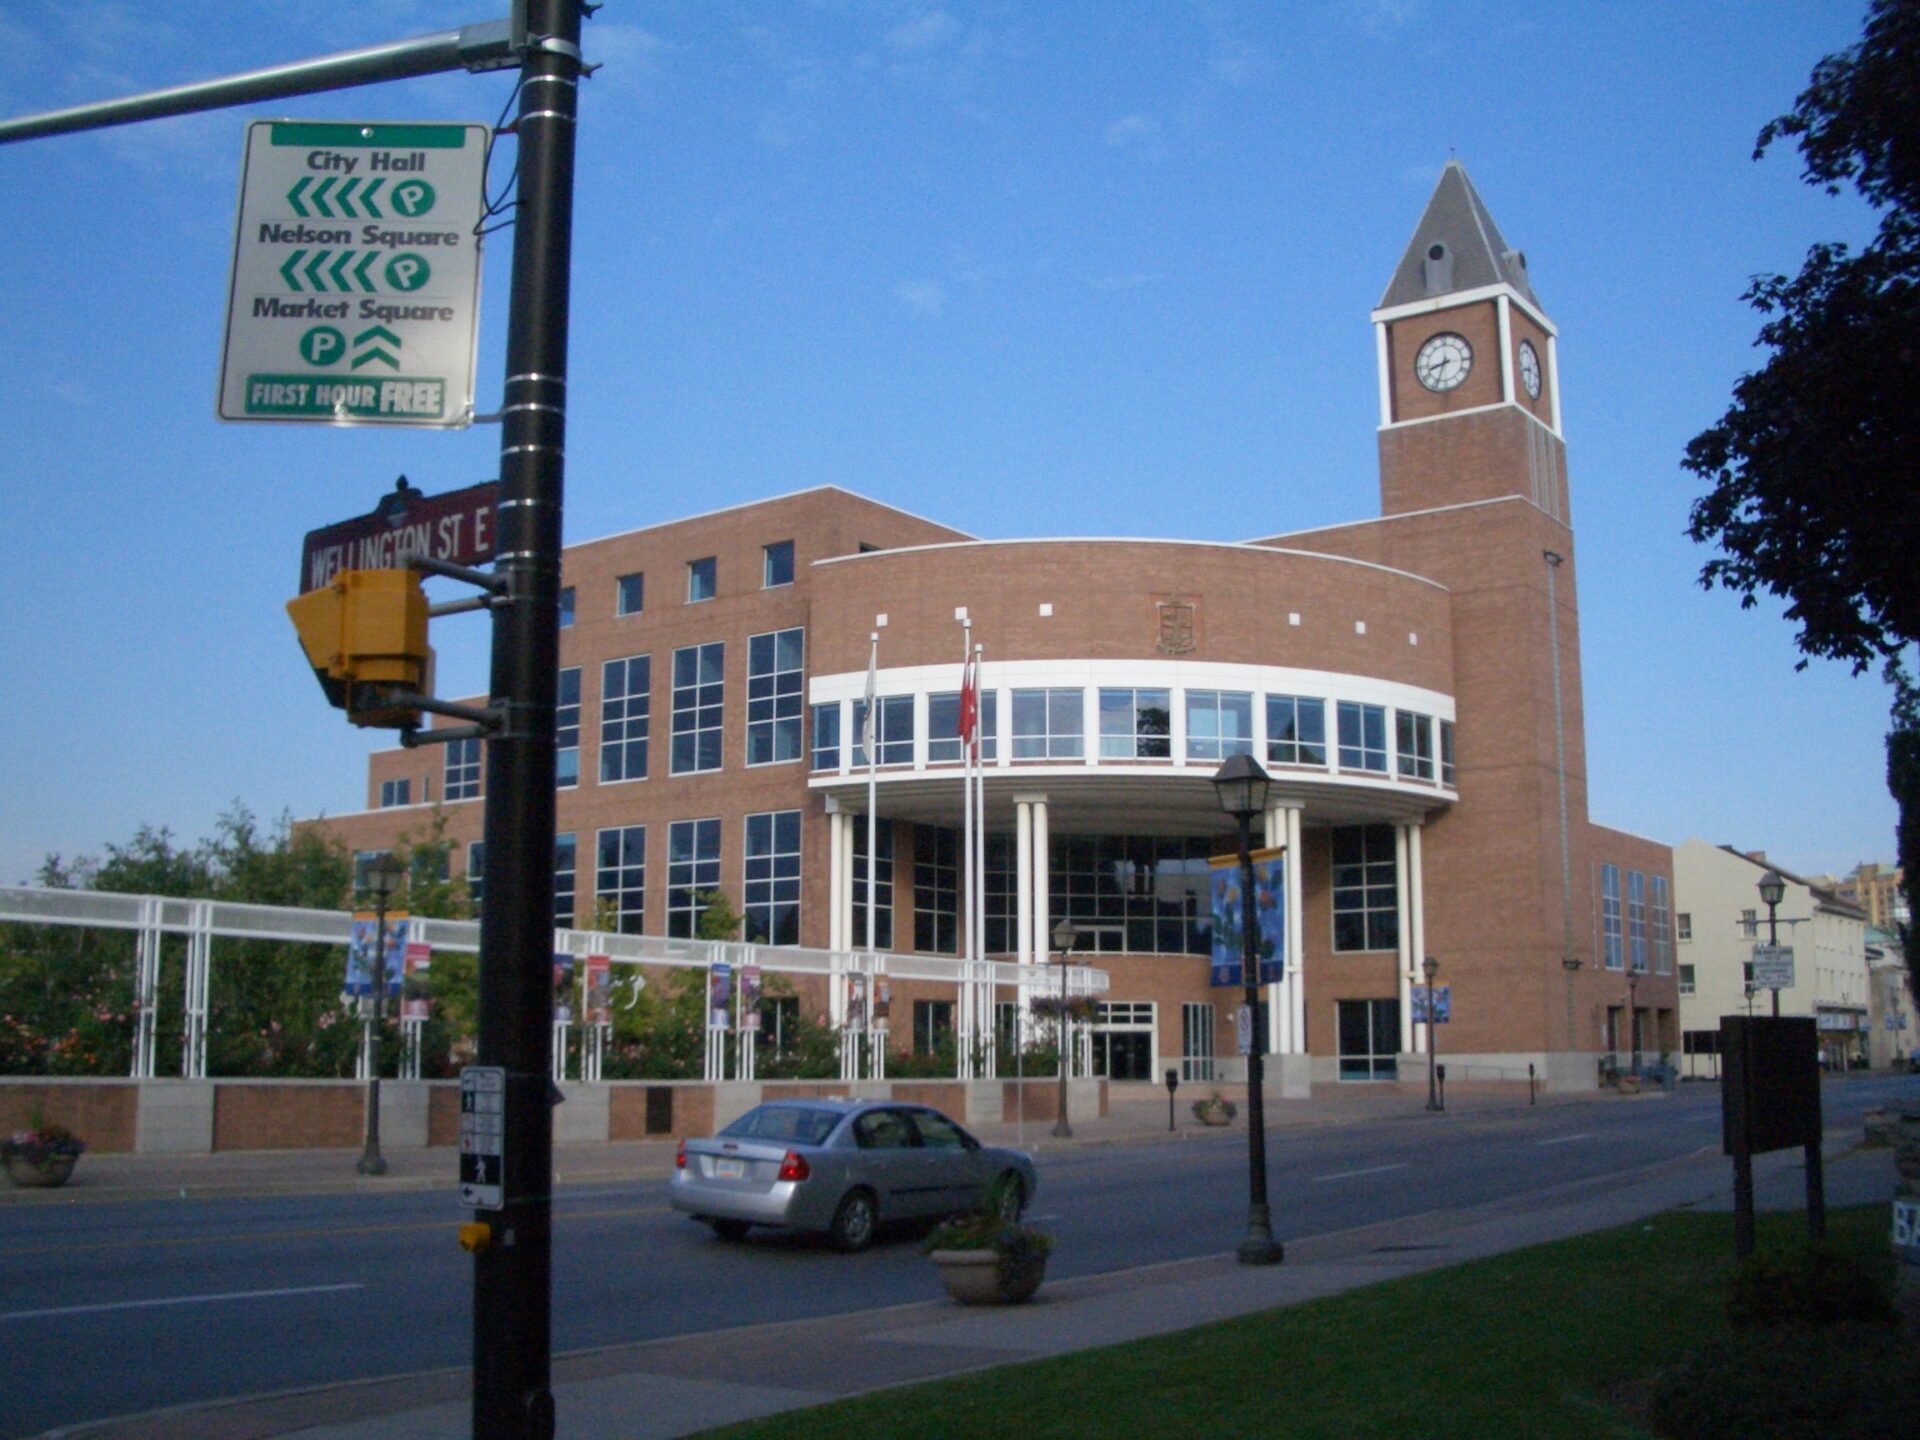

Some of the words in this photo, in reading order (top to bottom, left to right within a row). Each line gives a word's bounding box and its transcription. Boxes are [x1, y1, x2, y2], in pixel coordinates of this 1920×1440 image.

[306, 150, 359, 174] City
[370, 151, 426, 171] Hall
[400, 185, 424, 214] P
[258, 223, 352, 244] Nelson
[361, 225, 460, 248] Square
[393, 259, 419, 289] P
[252, 297, 350, 319] Market
[358, 299, 455, 323] Square
[311, 332, 337, 361] P
[251, 383, 310, 405] FIRST
[314, 384, 376, 407] HOUR
[379, 381, 441, 413] FREE
[438, 513, 464, 561] ST
[474, 506, 490, 552] E
